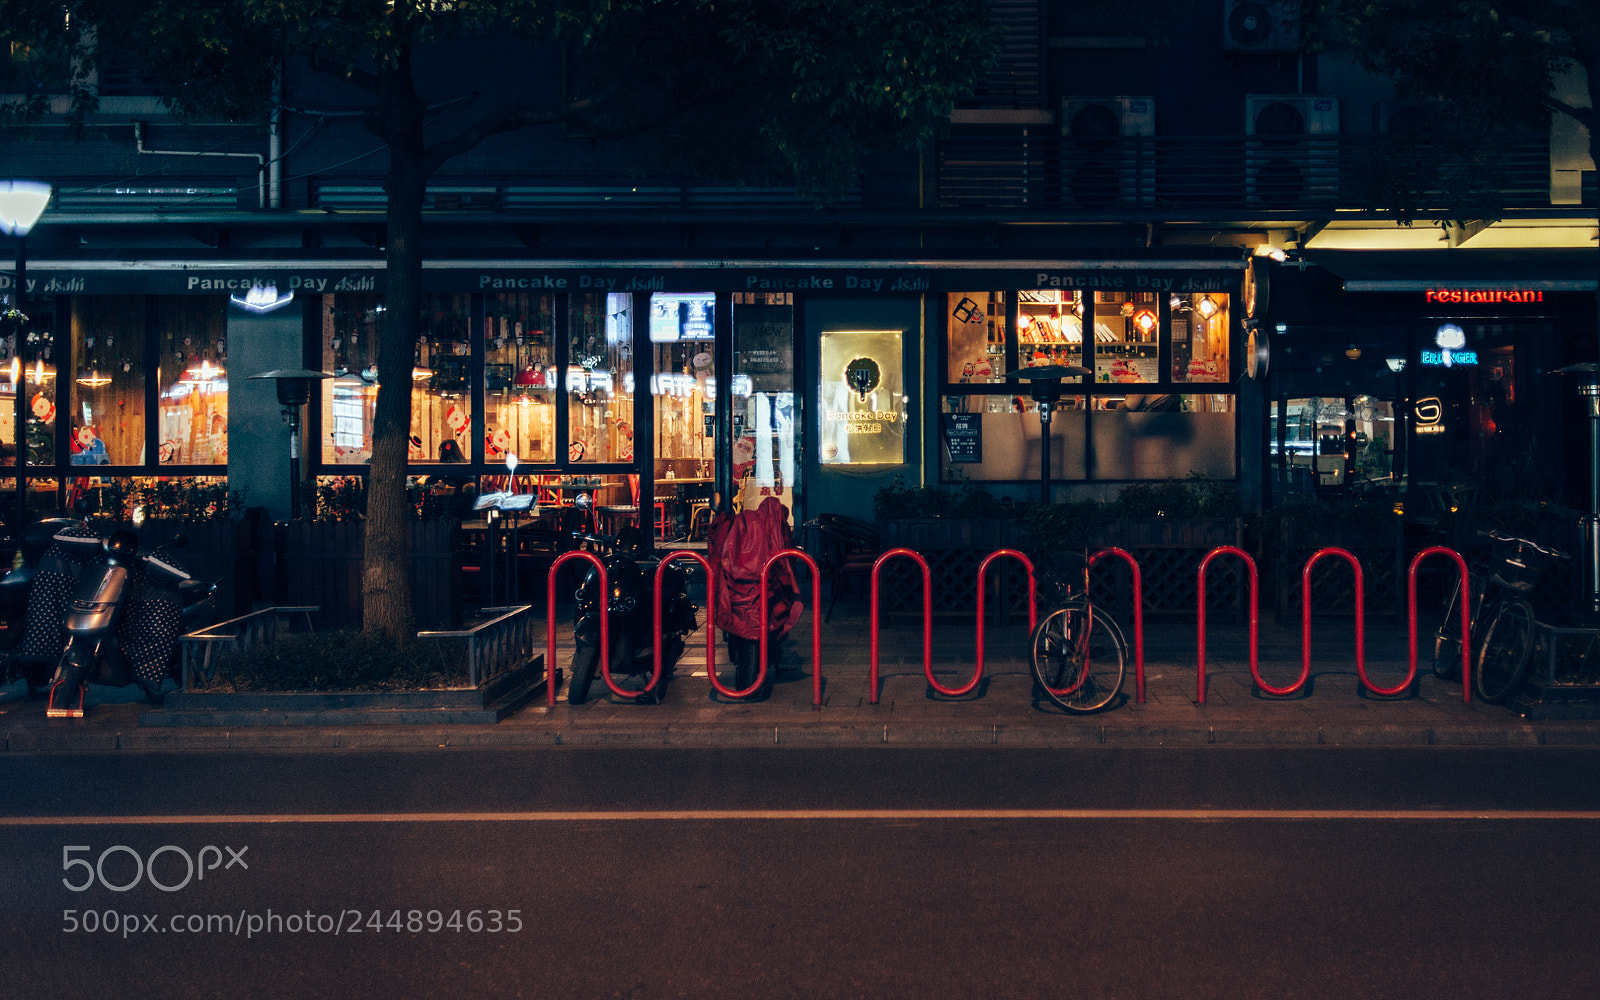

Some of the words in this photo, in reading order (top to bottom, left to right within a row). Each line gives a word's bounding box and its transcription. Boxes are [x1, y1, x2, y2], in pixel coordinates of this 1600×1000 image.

[187, 276, 277, 290] Pancake
[289, 276, 328, 291] Day
[335, 275, 375, 291] Asahi
[479, 275, 568, 289] Pancake
[579, 275, 616, 291] Day
[745, 275, 834, 289] Pancake
[846, 275, 884, 291] Day
[1036, 273, 1126, 288] Pancake
[1136, 274, 1175, 291] Day
[1425, 289, 1544, 303] restaurant
[1422, 351, 1479, 365] ERDNGER
[827, 410, 874, 421] Pancake
[875, 410, 898, 423] Day
